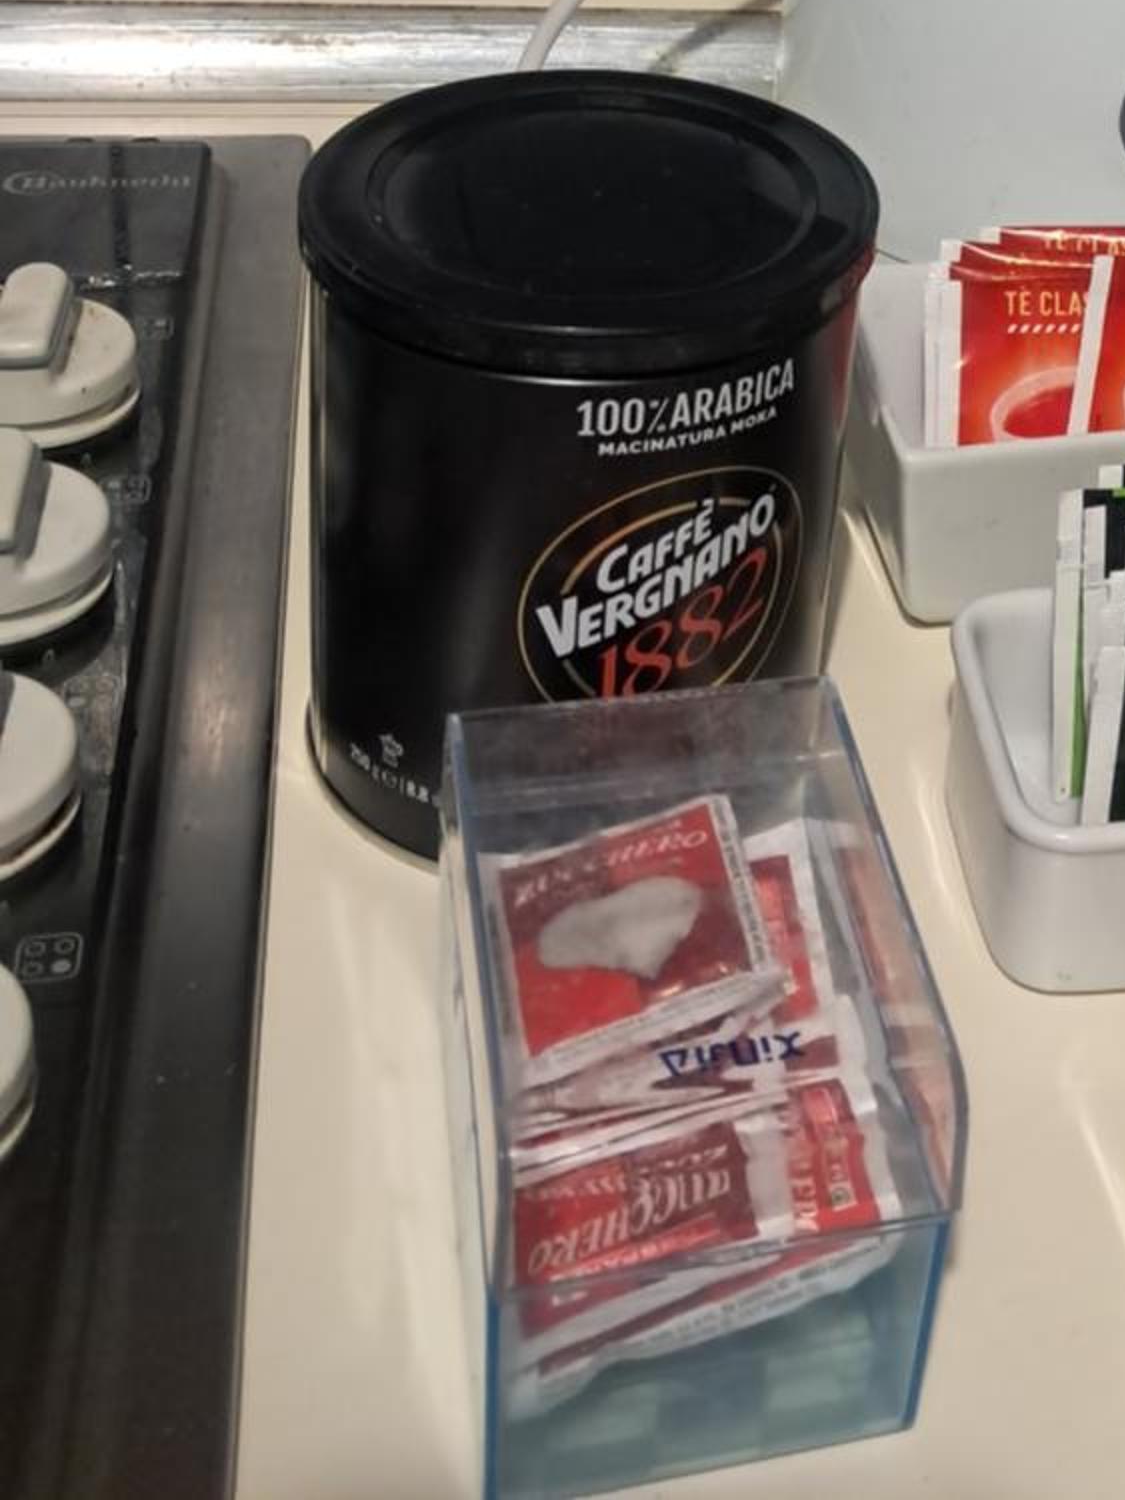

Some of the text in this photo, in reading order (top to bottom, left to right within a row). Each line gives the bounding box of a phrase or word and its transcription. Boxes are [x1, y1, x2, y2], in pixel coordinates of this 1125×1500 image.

[1003, 285, 1032, 317] TÈ
[599, 405, 777, 456] MACINATURA MOKA
[535, 493, 776, 659] VERGNANO
[599, 548, 769, 700] 1882
